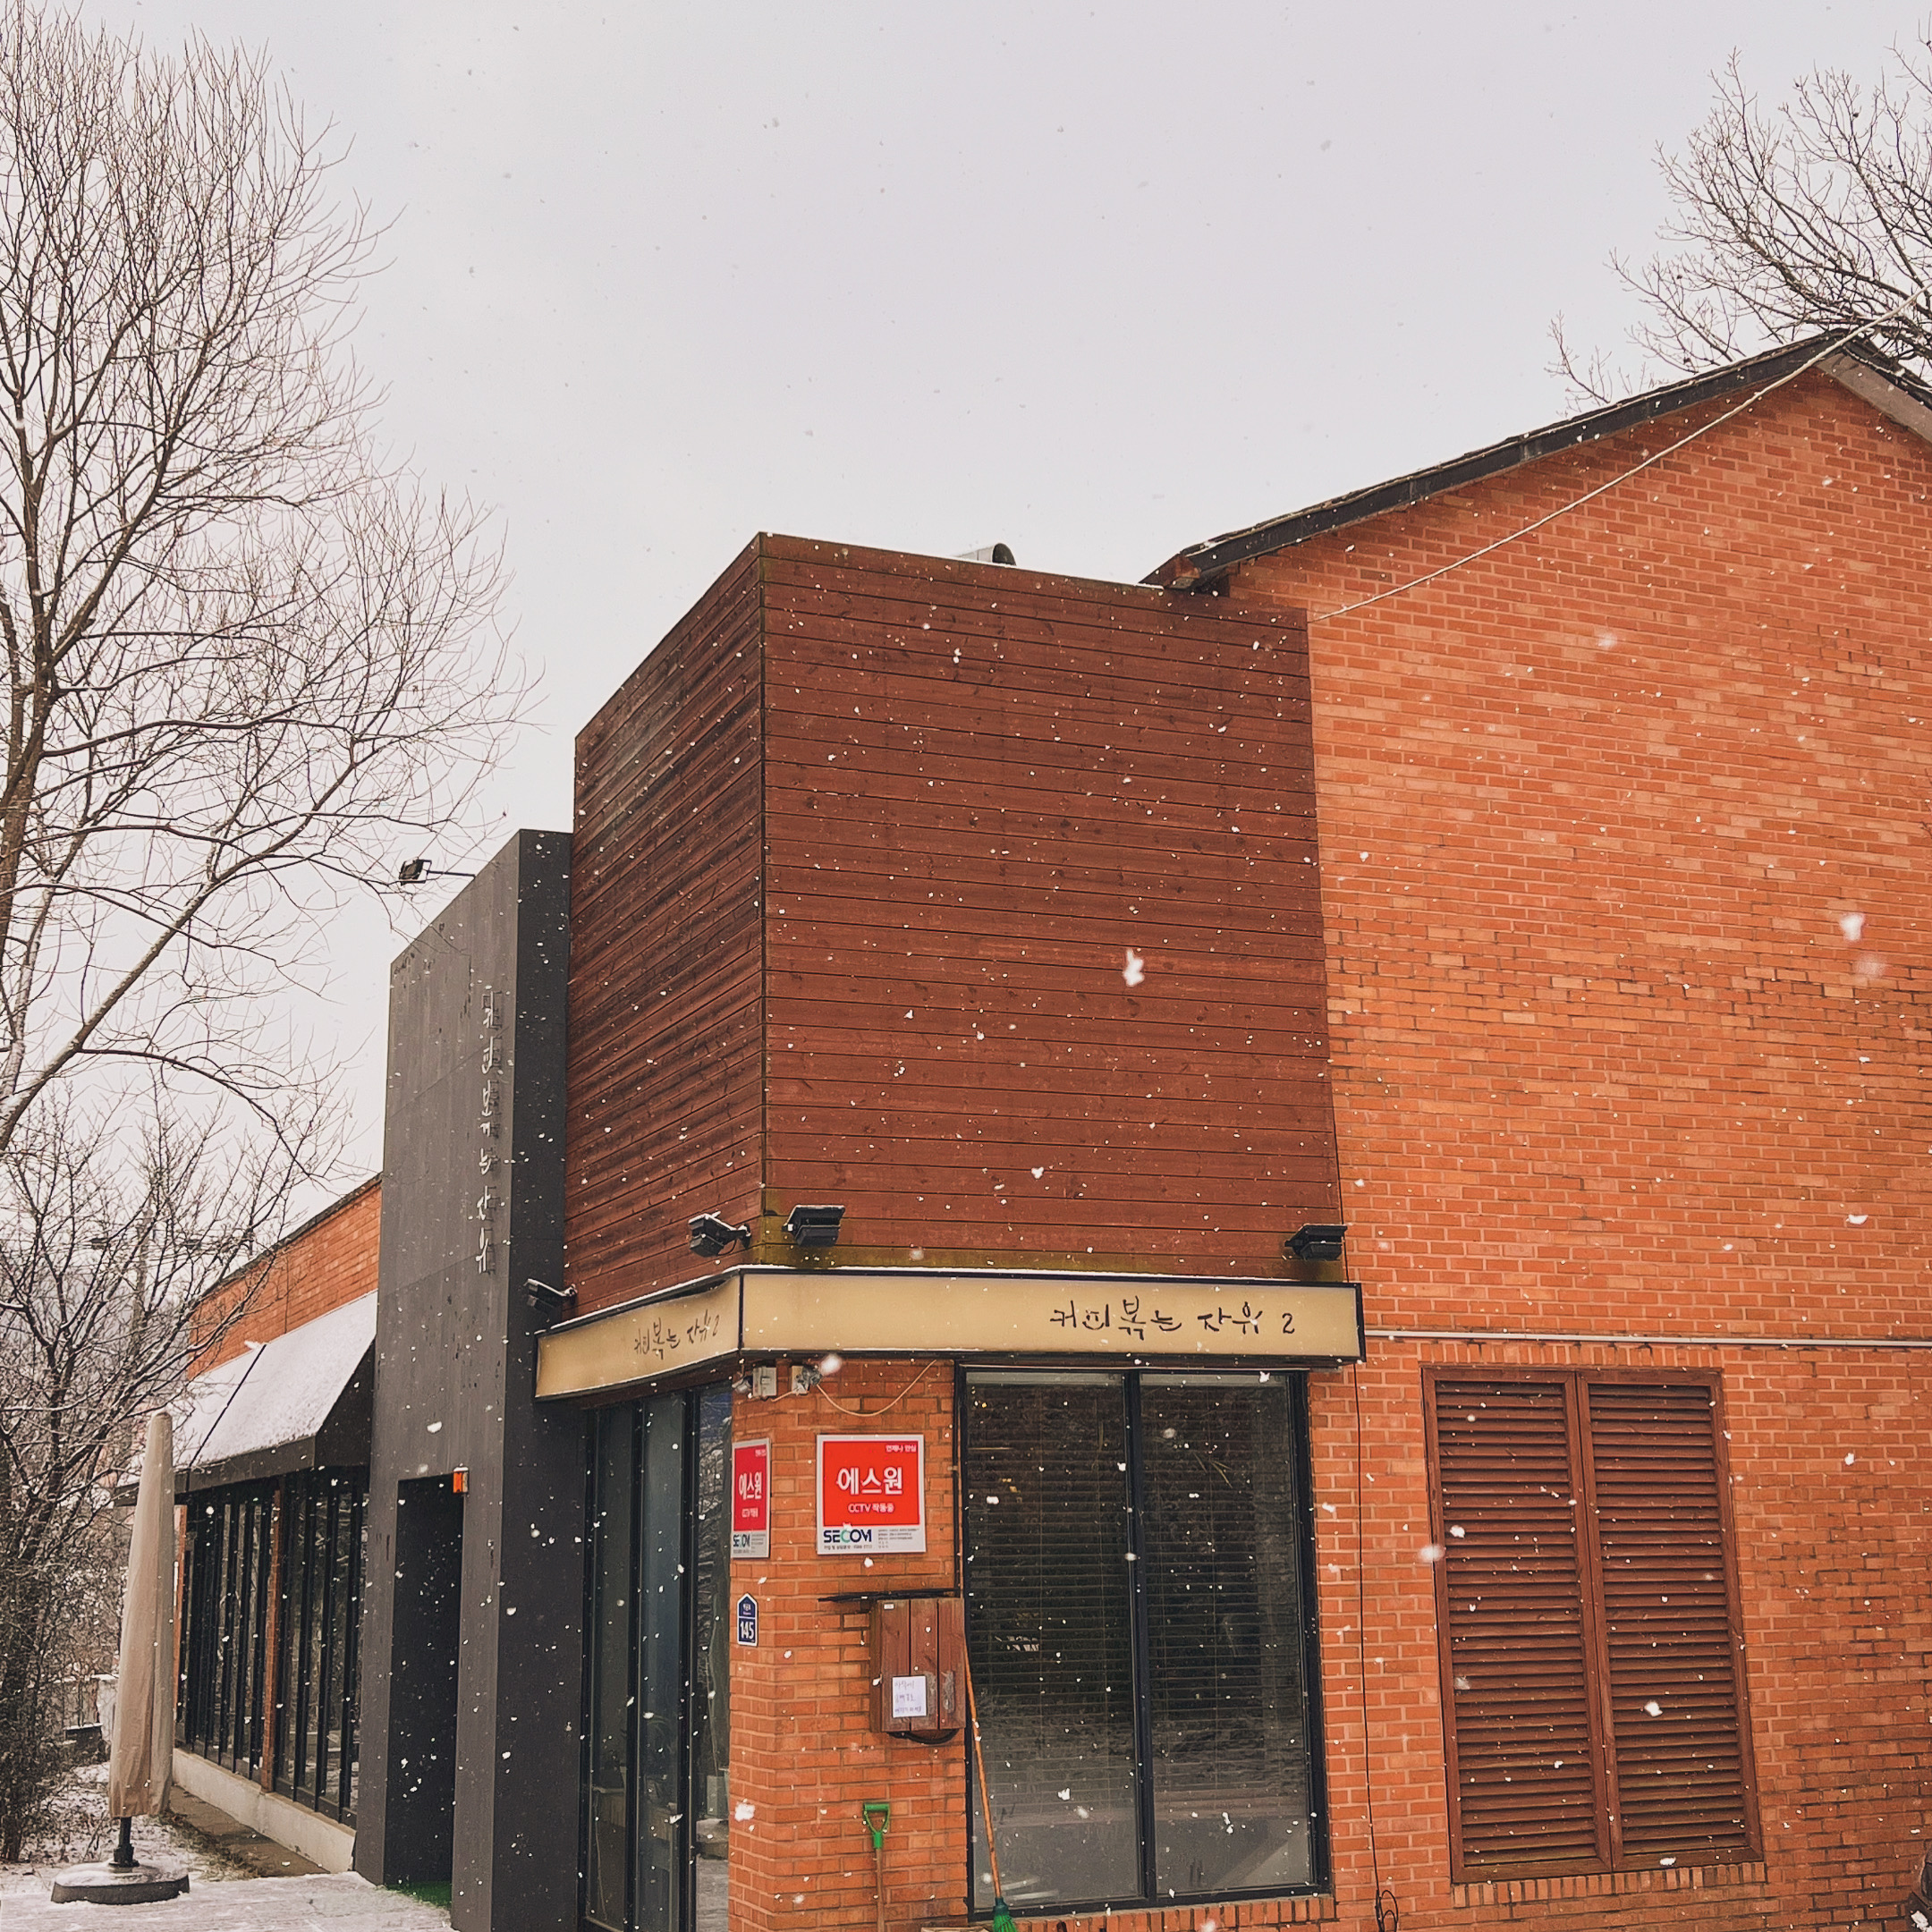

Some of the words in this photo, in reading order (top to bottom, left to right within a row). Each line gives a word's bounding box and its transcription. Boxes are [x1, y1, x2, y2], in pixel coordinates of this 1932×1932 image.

[1049, 1295, 1182, 1341] 커피볶는
[1197, 1301, 1263, 1335] 자유
[1282, 1313, 1295, 1334] 2
[633, 1317, 681, 1360] 커피볶는
[739, 1471, 762, 1500] 에스원
[836, 1467, 902, 1495] 에스원
[848, 1504, 871, 1513] CCTV
[823, 1529, 872, 1543] SECOM
[740, 1621, 755, 1640] 145
